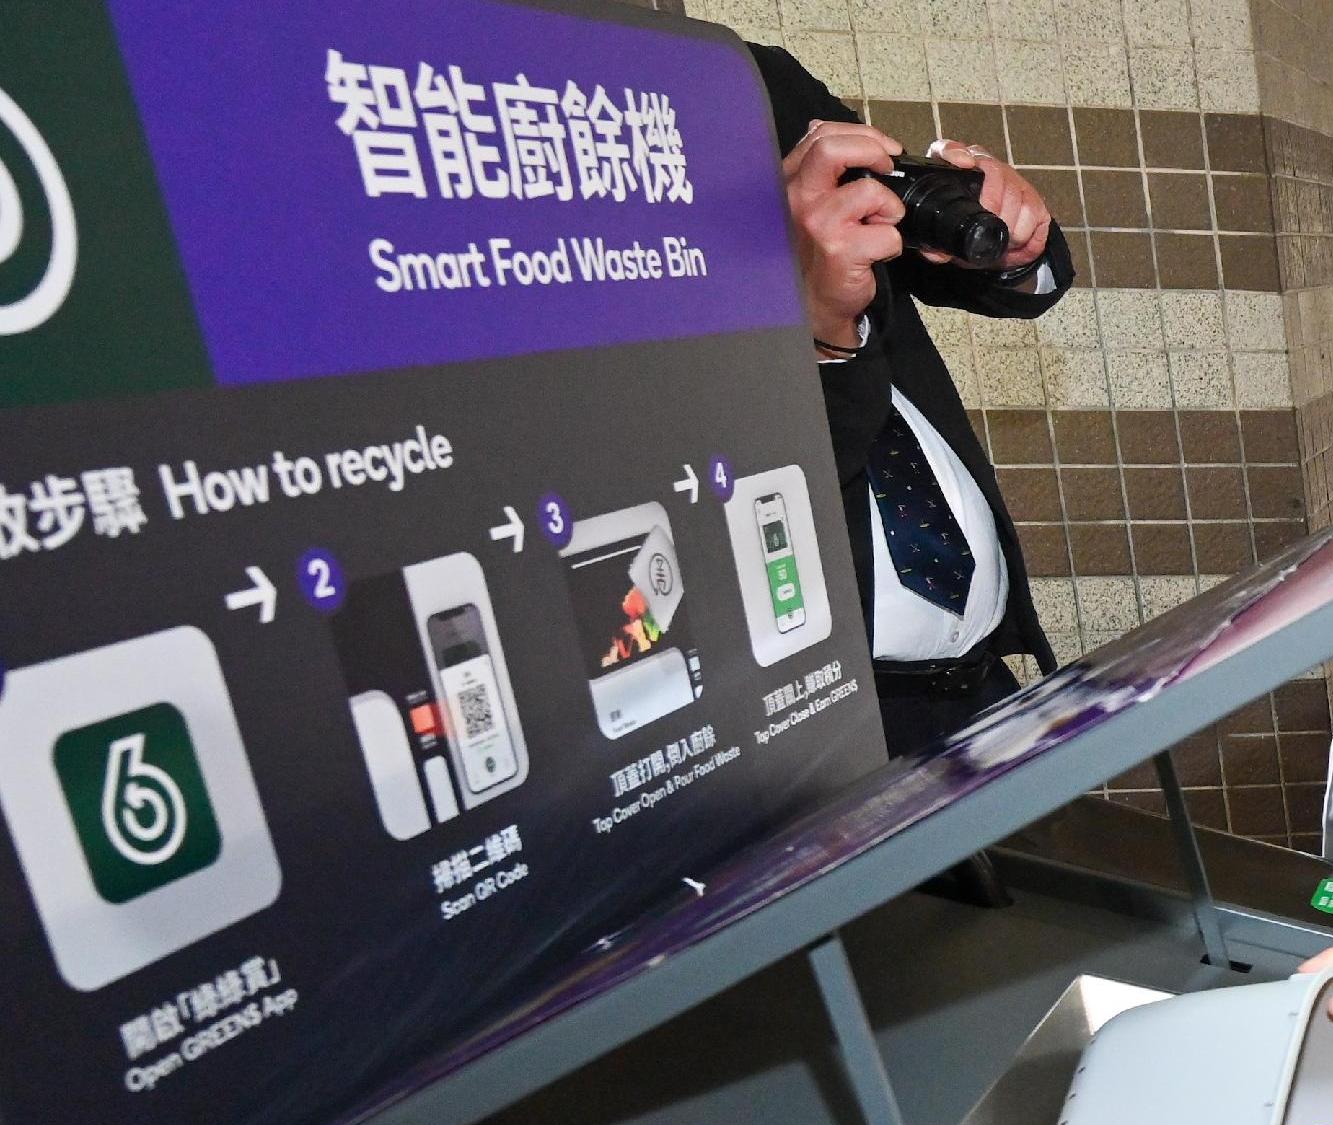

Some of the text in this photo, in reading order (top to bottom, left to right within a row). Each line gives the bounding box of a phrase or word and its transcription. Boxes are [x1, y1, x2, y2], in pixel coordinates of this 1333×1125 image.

[325, 49, 693, 204] 智能廚餘機
[369, 236, 707, 292] Smart Food Waste Bin
[158, 460, 270, 520] How
[273, 450, 323, 497] to
[325, 425, 454, 491] recycle
[715, 462, 728, 488] 4
[546, 502, 564, 534] 3
[307, 558, 336, 598] 2
[592, 746, 741, 834] Top Cover Open & Pour Food Waste
[440, 863, 529, 920] Scan QR Code
[125, 1052, 184, 1092] Open
[262, 988, 298, 1018] App
